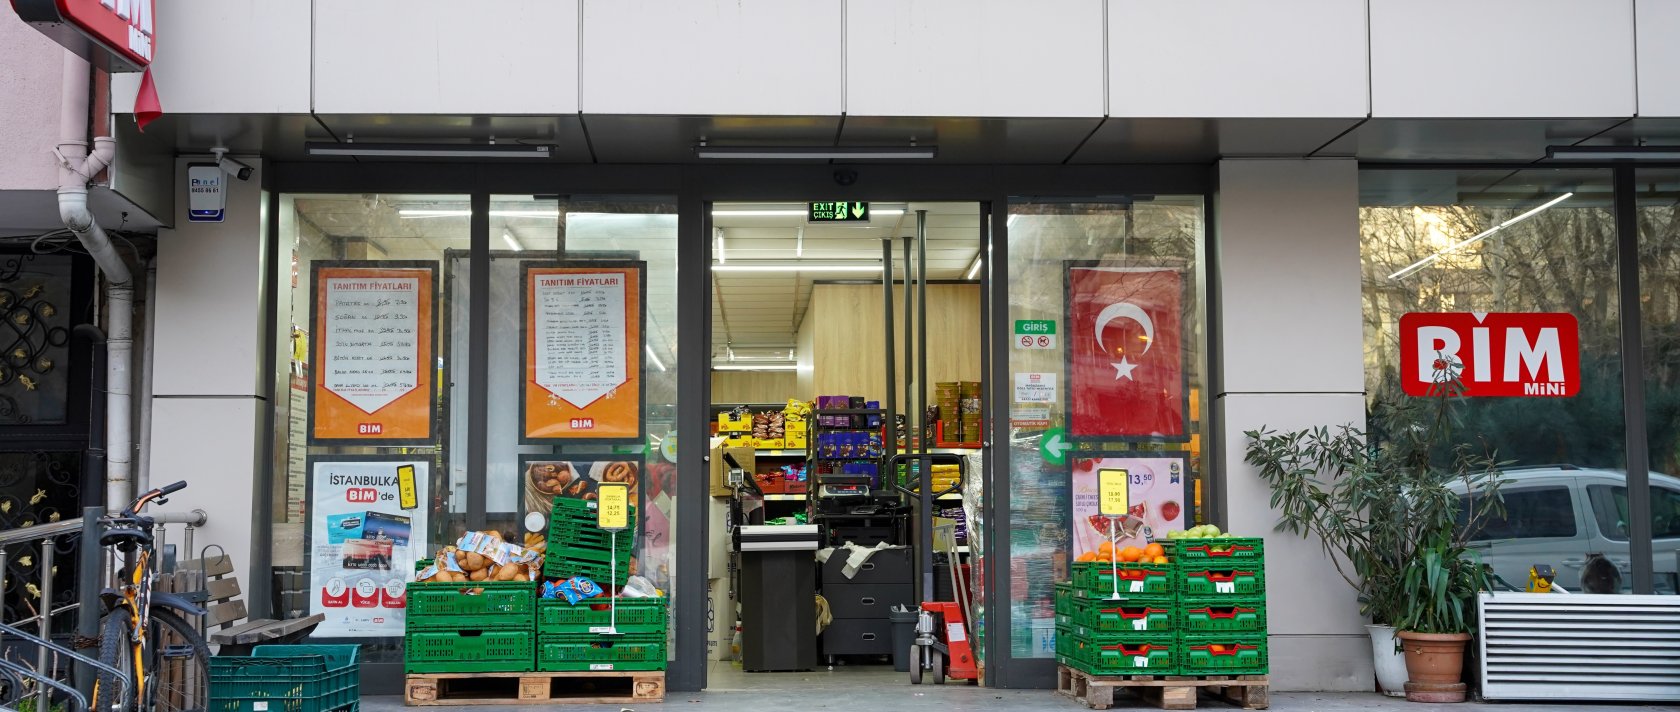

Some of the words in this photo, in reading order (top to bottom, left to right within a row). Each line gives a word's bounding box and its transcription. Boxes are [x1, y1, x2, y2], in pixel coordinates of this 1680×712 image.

[813, 203, 834, 211] EXIT
[813, 211, 834, 219] ÇIKIŞ
[333, 282, 367, 291] TANITIM
[369, 281, 412, 291] FİYATLARI
[540, 279, 574, 287] TANITIM
[576, 277, 619, 286] FİYATLARI
[1022, 321, 1049, 333] GİRİŞ
[1524, 382, 1566, 396] MiNi
[330, 472, 398, 487] İSTANBULKA
